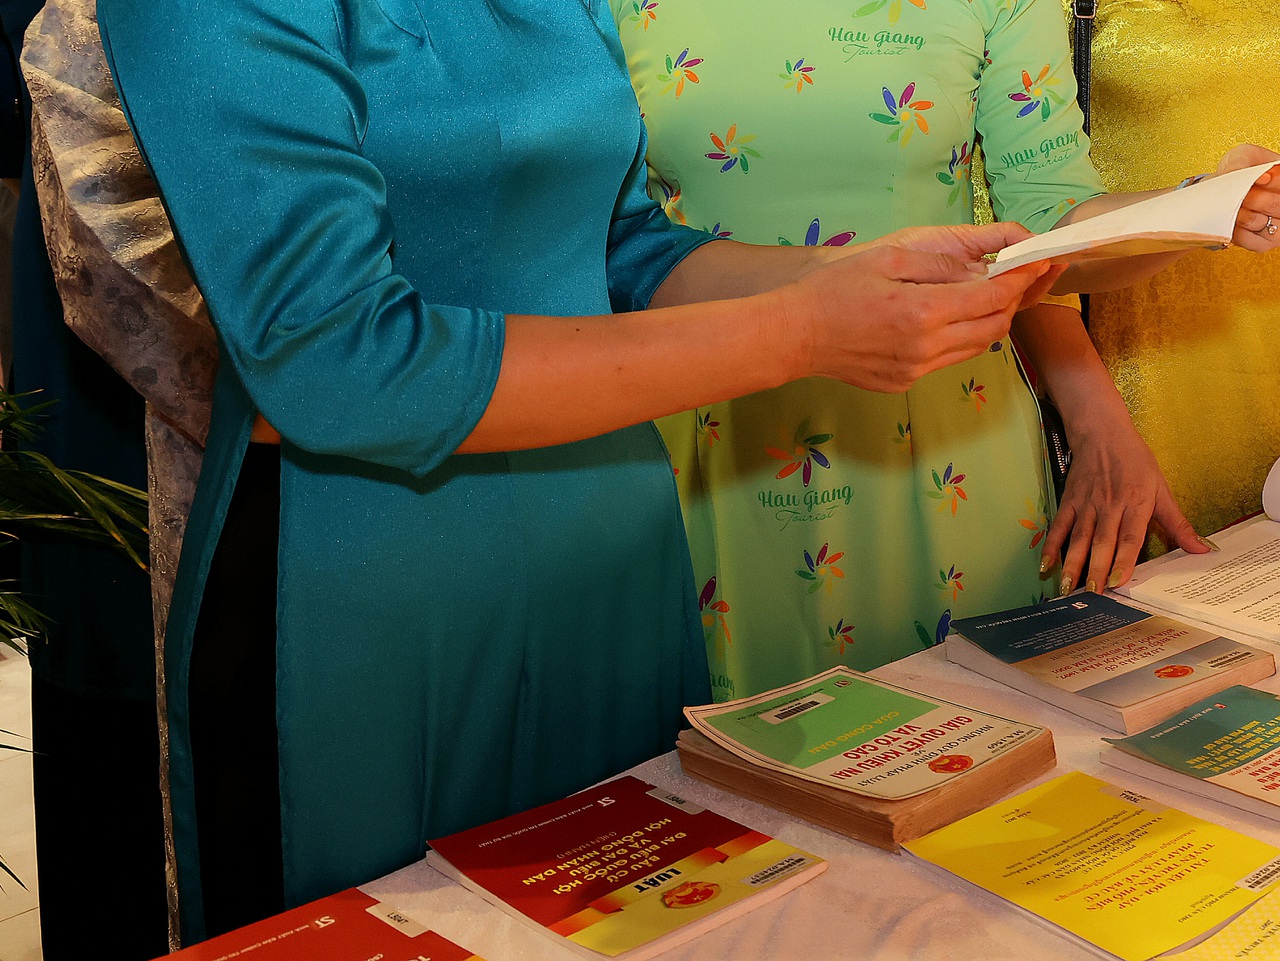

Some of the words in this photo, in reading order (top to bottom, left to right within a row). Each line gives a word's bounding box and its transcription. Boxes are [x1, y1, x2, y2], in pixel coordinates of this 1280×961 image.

[828, 26, 870, 42] Hau
[874, 30, 926, 50] Giang
[842, 43, 910, 63] Tourist
[758, 490, 800, 508] Hau
[804, 485, 854, 512] Giang
[775, 504, 839, 532] Tourist
[889, 723, 927, 737] VÀ
[934, 714, 981, 731] GIẢI
[869, 733, 908, 748] TỐ
[889, 727, 956, 753] QUYẾT
[951, 724, 997, 742] NHỮNG
[837, 742, 885, 761] CÁO
[931, 740, 963, 753] QUY
[851, 748, 909, 771] KHIẾU
[907, 751, 941, 765] ĐỊNH
[830, 767, 863, 780] NẠI
[882, 763, 916, 777] PHÁP
[857, 775, 887, 787] LUẬT
[640, 817, 674, 831] HỘI
[594, 830, 650, 852] ĐỒNG
[625, 837, 654, 849] VÀ
[655, 831, 690, 845] ĐẠI
[552, 850, 604, 871] NHÂN
[596, 847, 631, 861] ĐẠI
[624, 843, 666, 861] BIỂU
[564, 859, 606, 878] BIỂU
[578, 858, 634, 882] QUỐC
[625, 854, 666, 872] BẦU
[518, 868, 560, 886] DÂN
[601, 869, 635, 884] CỬ
[626, 867, 687, 893] LUẬT
[547, 878, 585, 895] HỘI
[308, 914, 339, 929] ST
